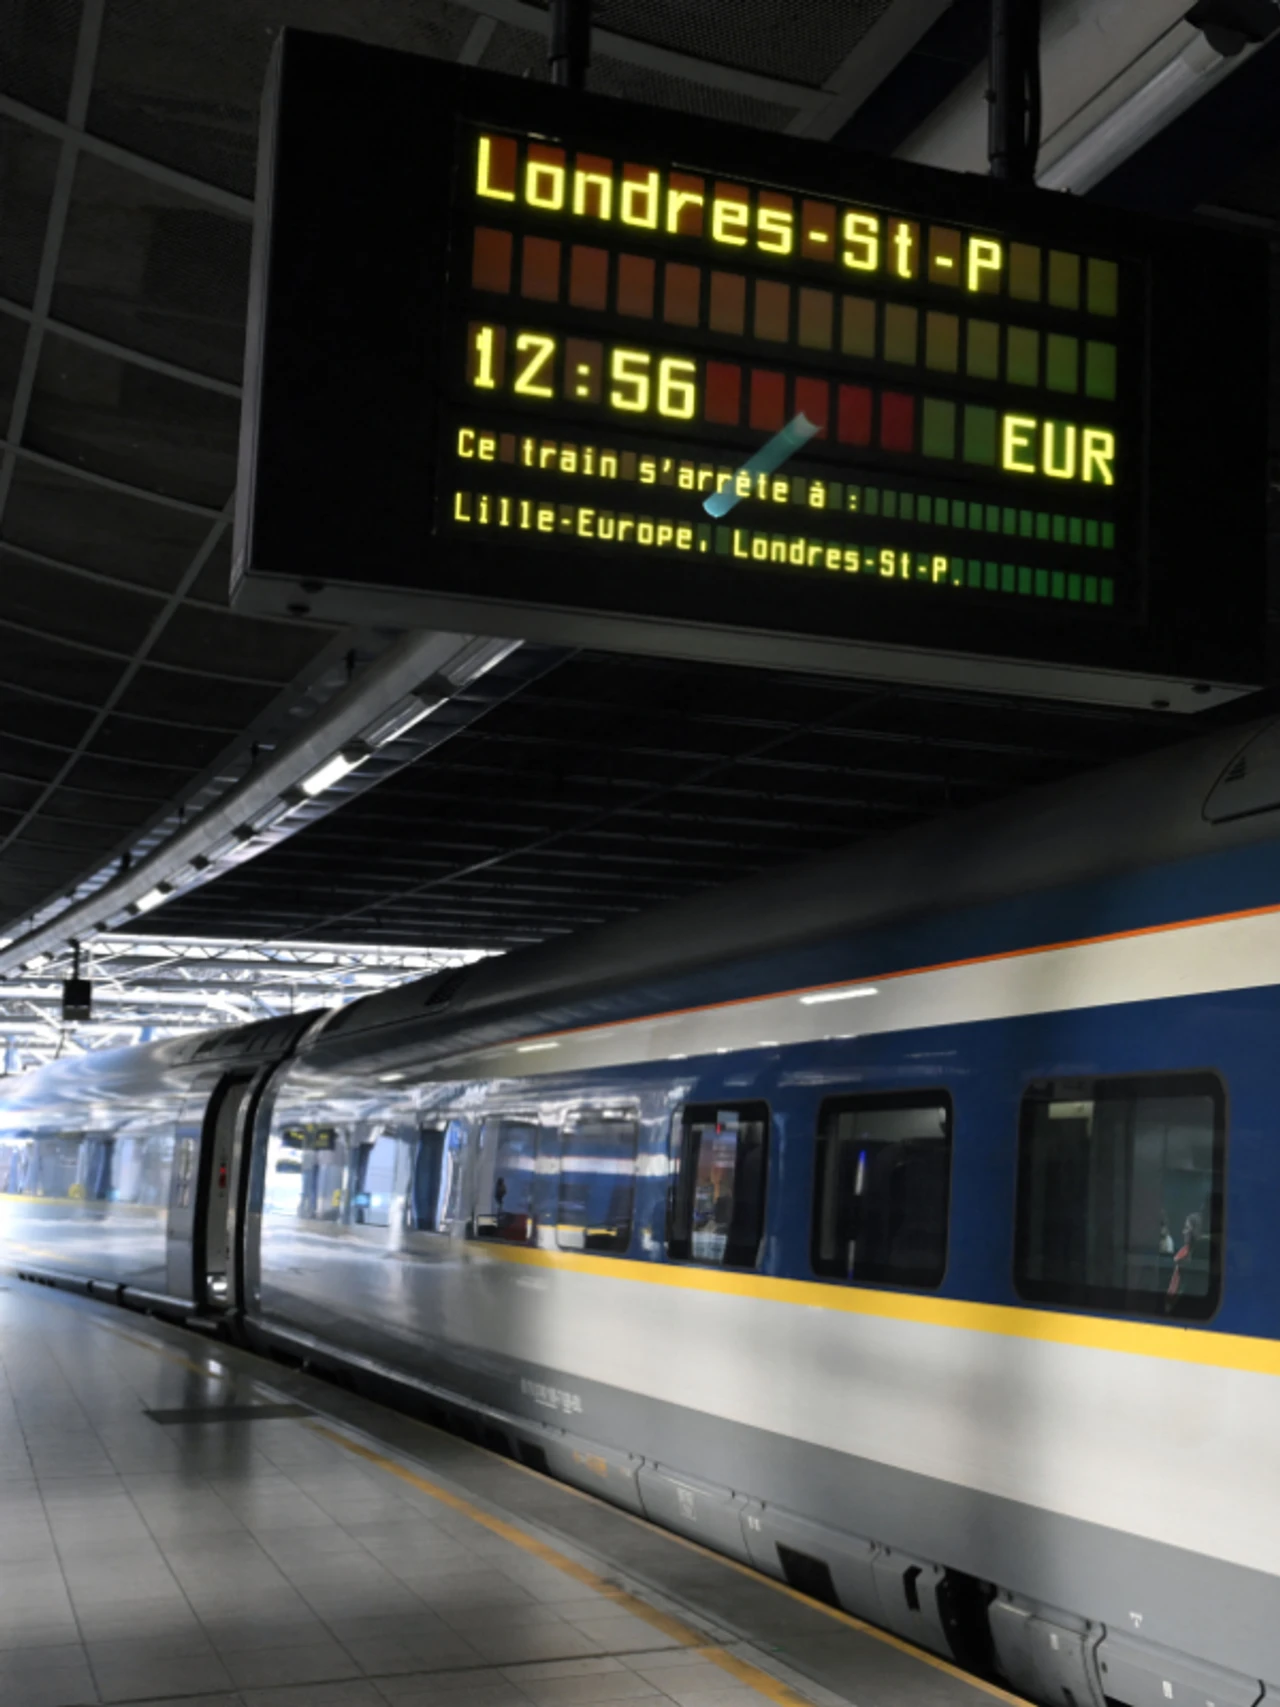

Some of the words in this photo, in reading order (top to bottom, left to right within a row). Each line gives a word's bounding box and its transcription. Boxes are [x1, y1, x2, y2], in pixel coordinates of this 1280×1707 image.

[475, 136, 1003, 293] Londres-St-P
[473, 326, 697, 420] 12:56
[458, 428, 496, 461] Ce
[522, 438, 618, 479] train
[639, 459, 789, 504] s'arrête
[809, 480, 826, 509] à
[1001, 414, 1115, 487] EUR
[454, 492, 708, 553] Lille-Europe,
[733, 529, 961, 587] Londres-St-P.
